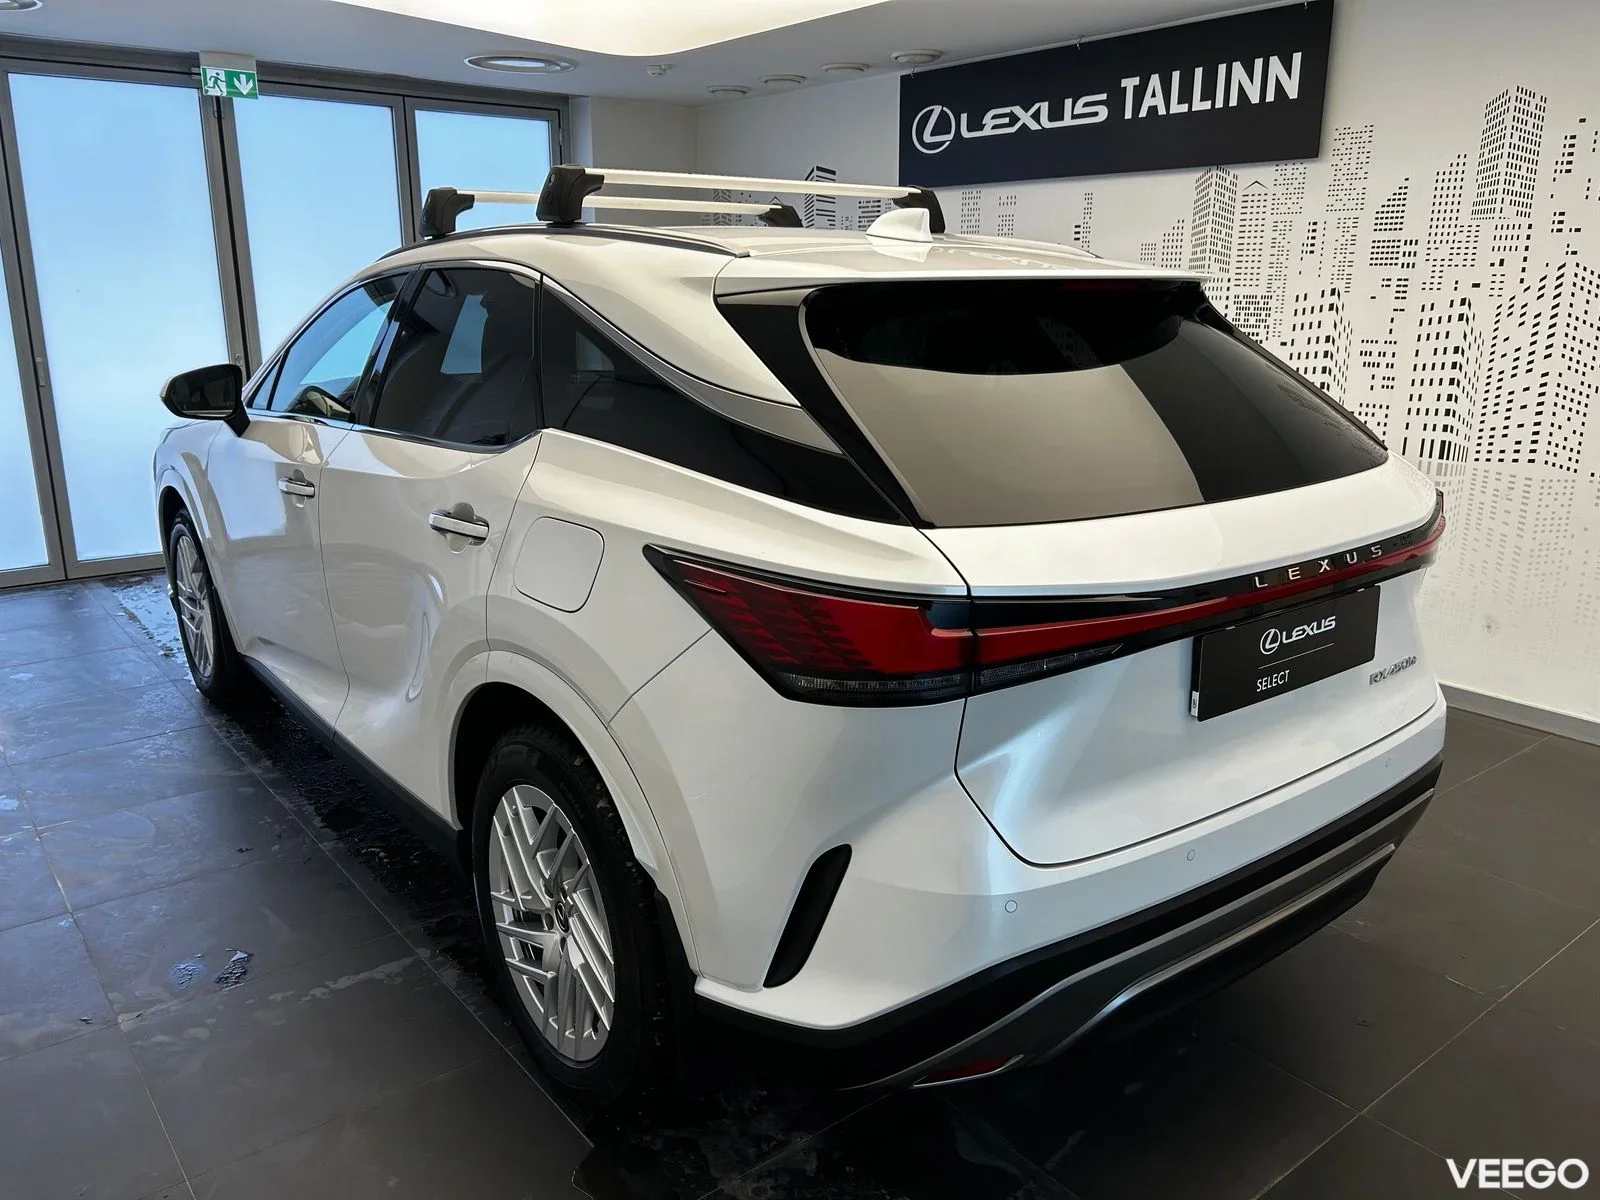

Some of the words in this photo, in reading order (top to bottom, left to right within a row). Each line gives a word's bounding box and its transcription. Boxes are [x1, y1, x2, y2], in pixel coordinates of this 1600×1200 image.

[960, 93, 1109, 139] LEXUS
[1120, 52, 1302, 120] TALLINN
[1254, 544, 1383, 588] LEXUS
[1282, 615, 1336, 644] LEXUS
[1256, 669, 1290, 692] SELECT
